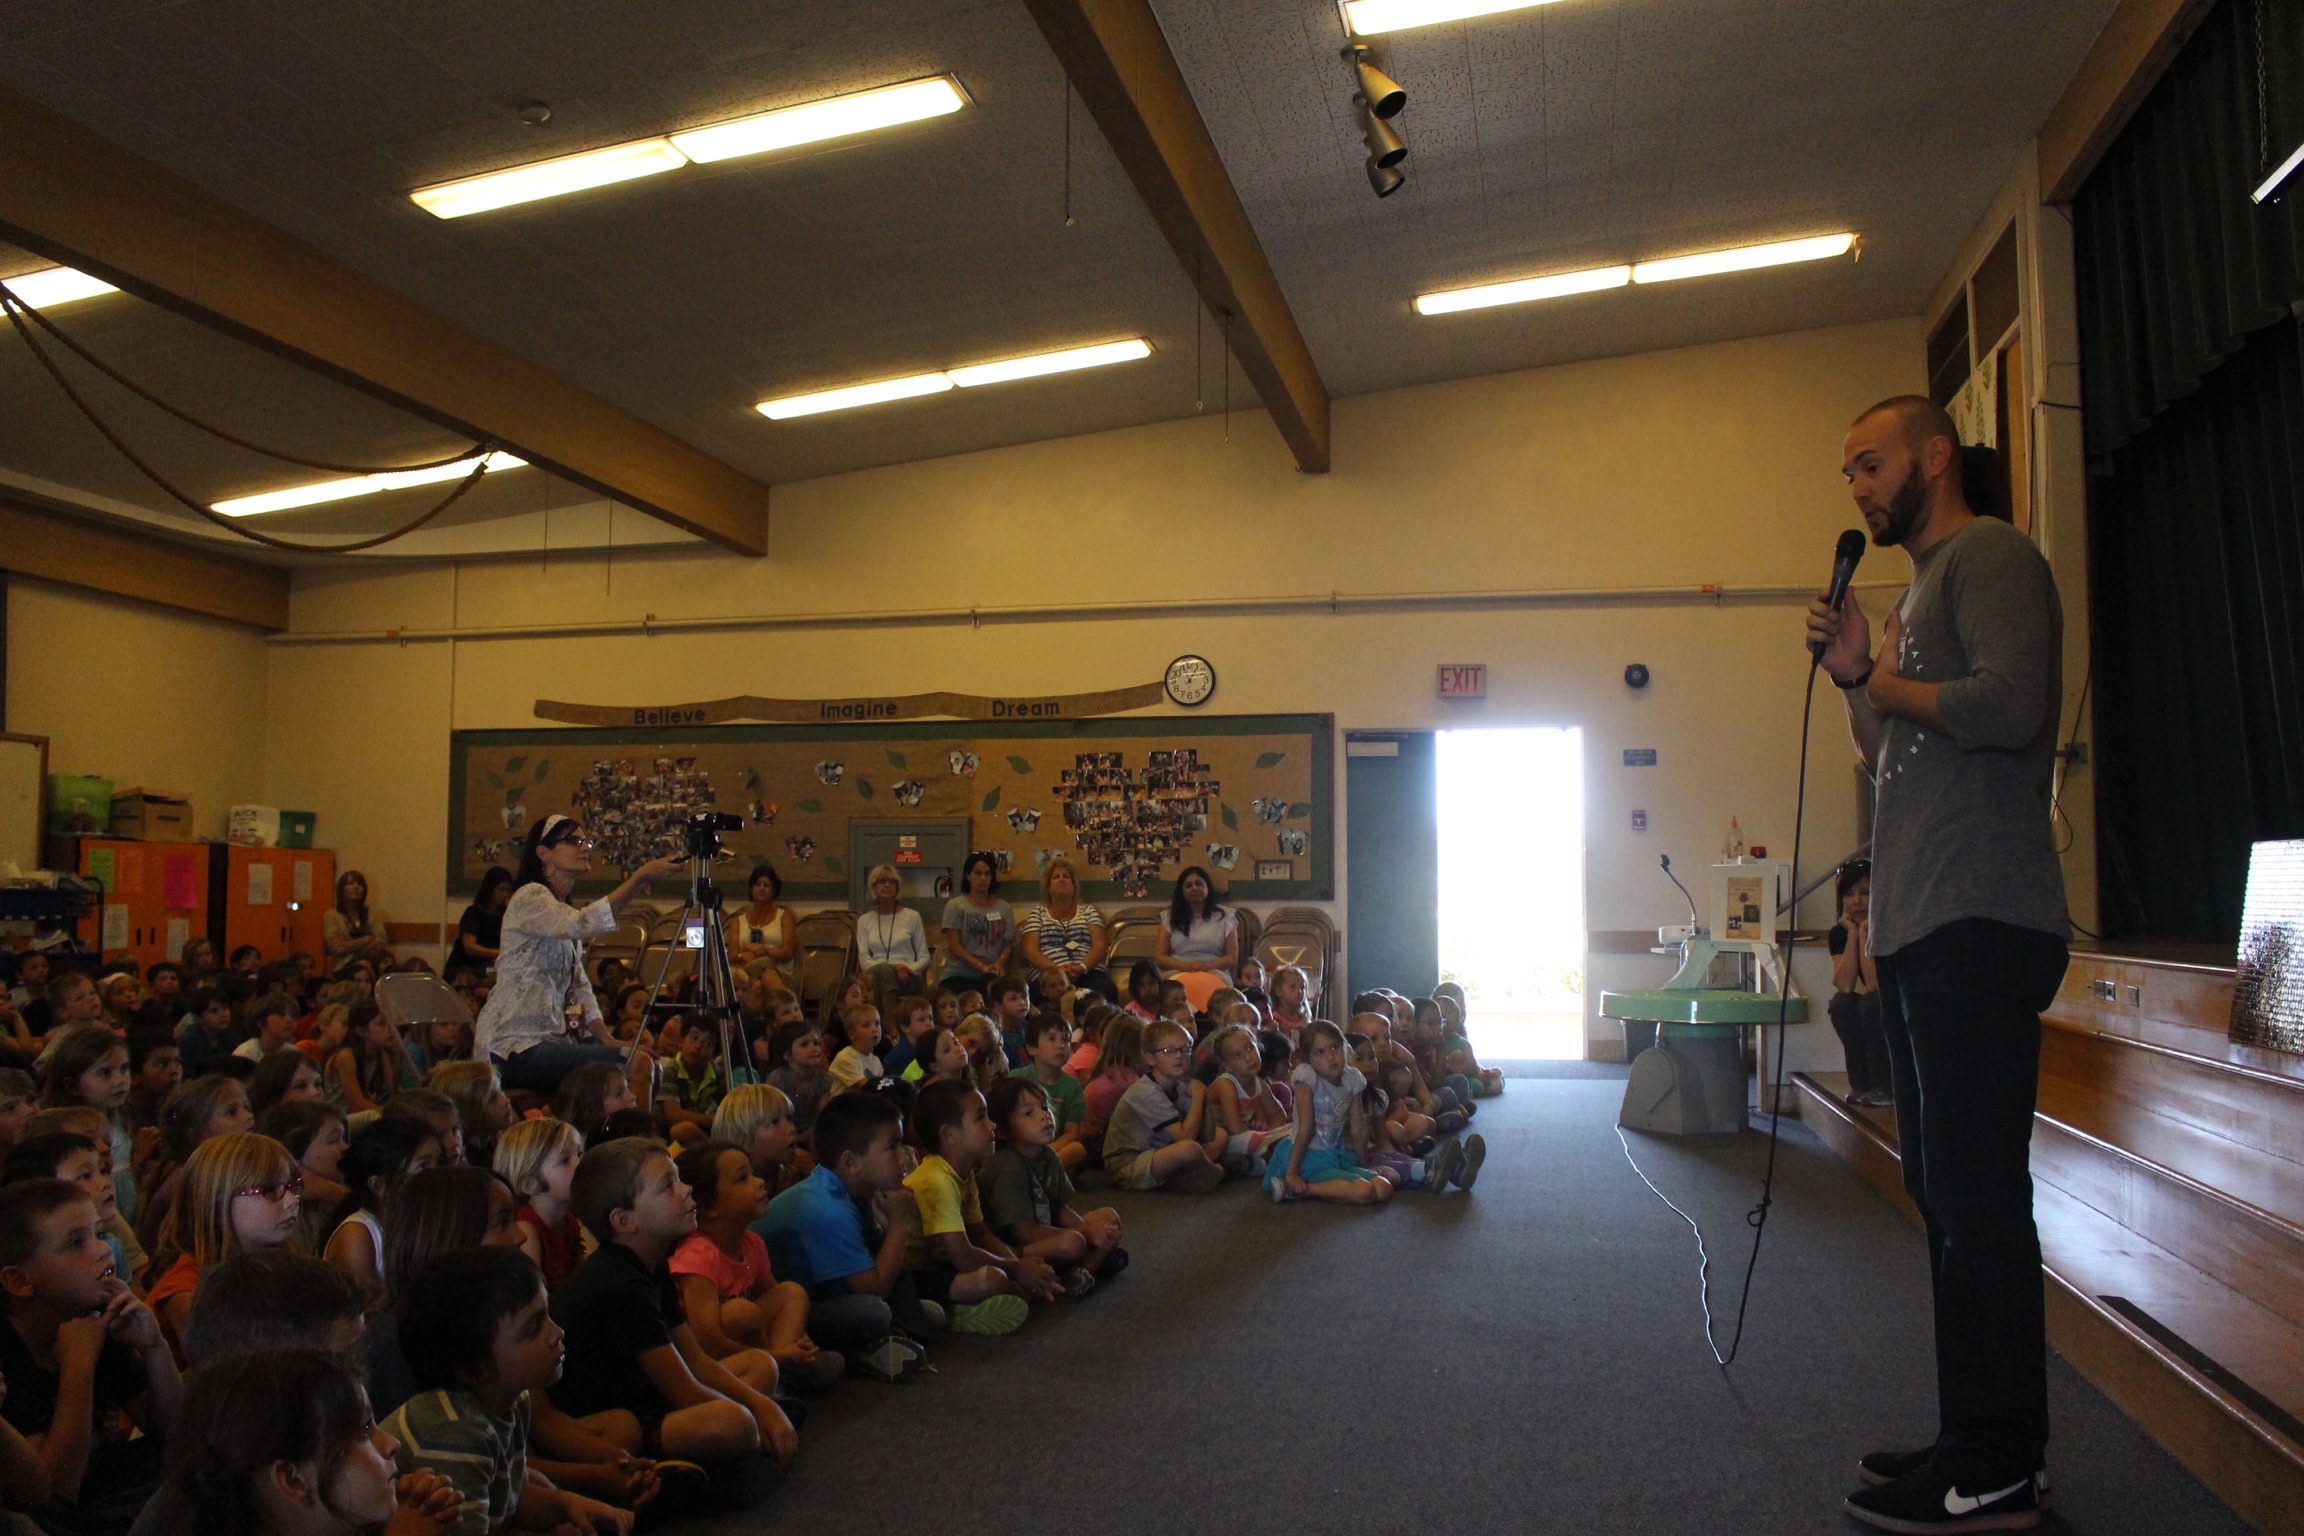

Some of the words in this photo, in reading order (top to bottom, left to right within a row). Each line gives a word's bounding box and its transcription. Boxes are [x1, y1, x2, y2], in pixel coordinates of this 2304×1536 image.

[1203, 676, 1209, 684] 3
[1440, 667, 1482, 693] EXIT
[1187, 692, 1193, 700] 6
[634, 708, 705, 724] Believe
[820, 701, 898, 720] Imagine
[992, 700, 1060, 717] Dream
